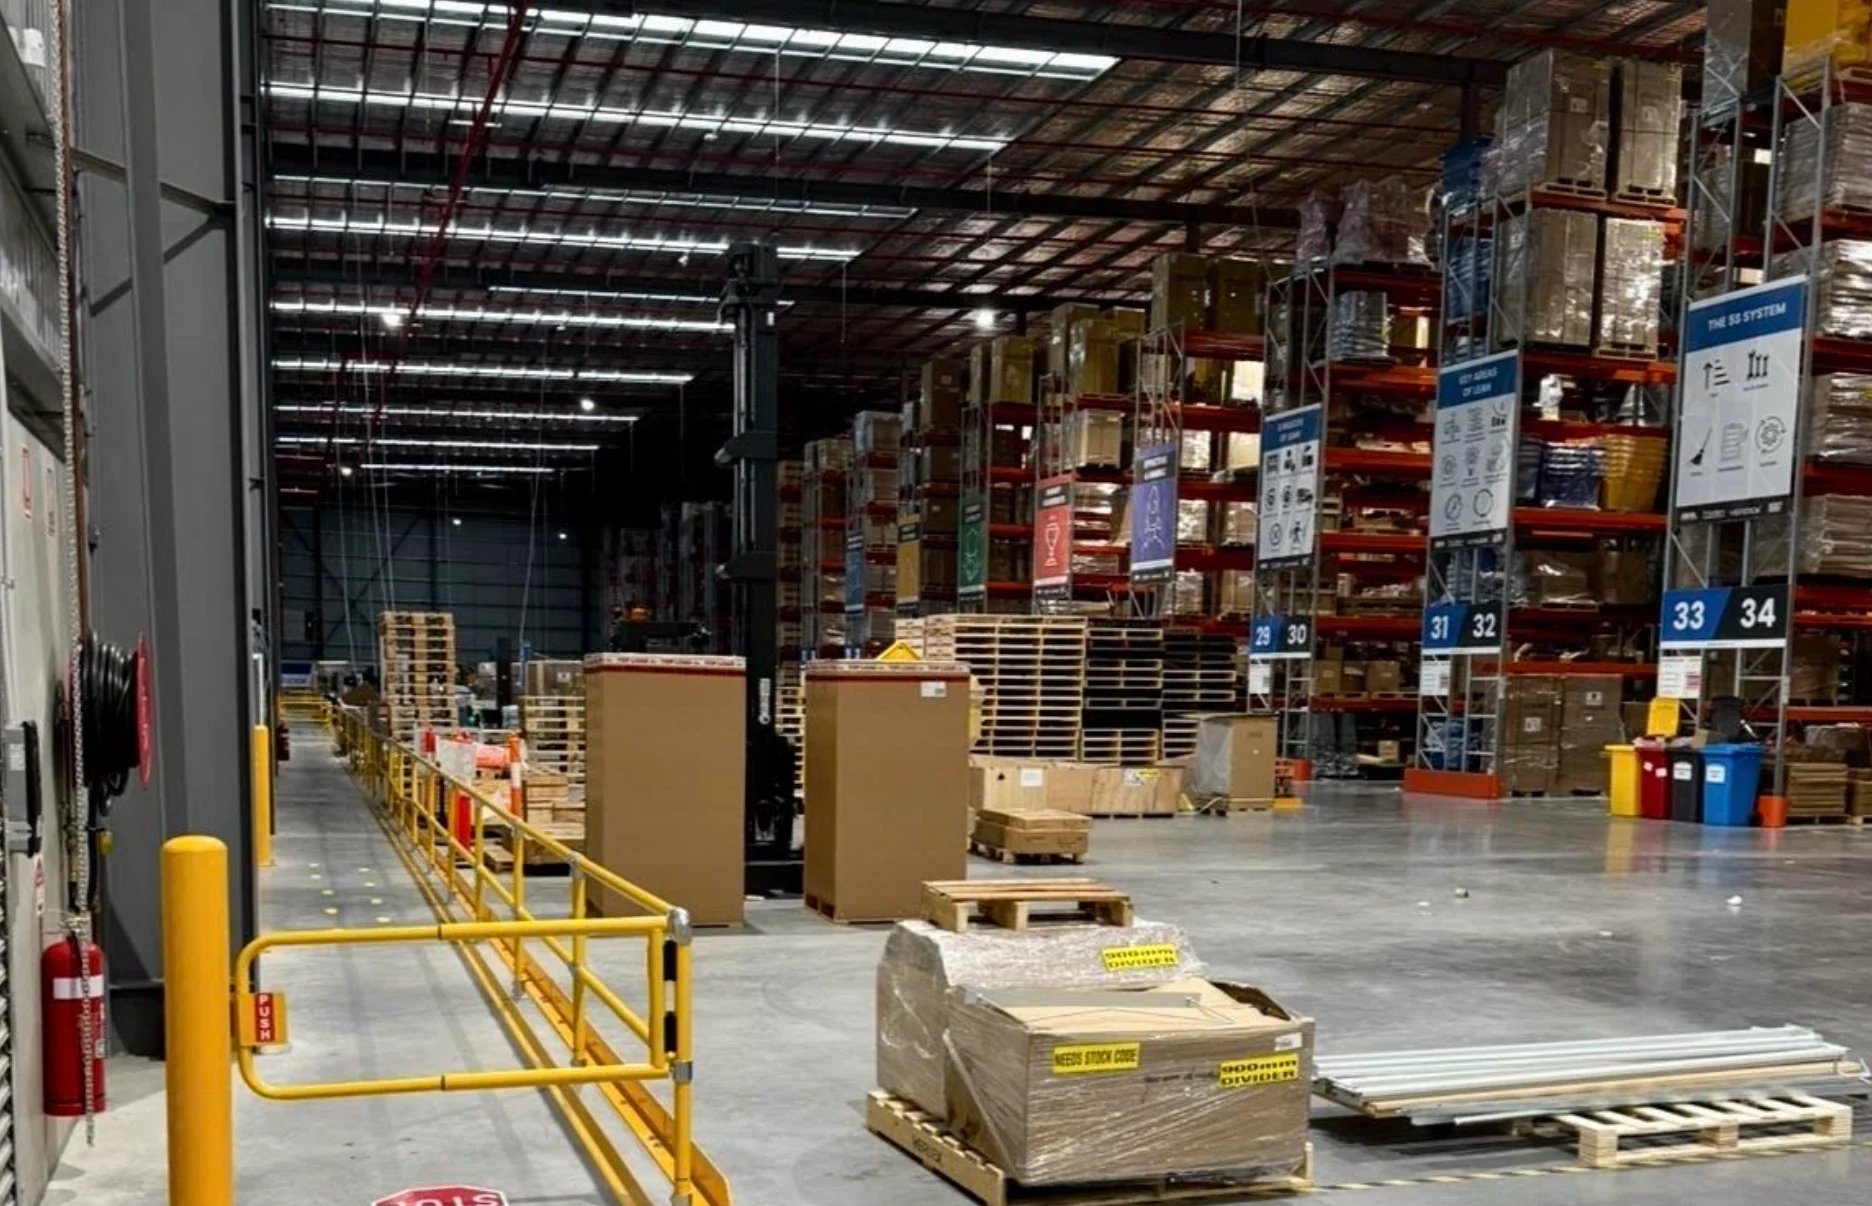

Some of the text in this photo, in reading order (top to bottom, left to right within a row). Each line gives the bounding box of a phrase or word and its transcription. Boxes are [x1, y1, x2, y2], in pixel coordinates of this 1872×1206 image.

[1708, 316, 1726, 331] THE
[1743, 302, 1787, 322] SYSTEM
[1673, 598, 1776, 630] 33 34
[1255, 624, 1307, 646] 29 30
[1430, 612, 1496, 639] 31 32
[1105, 949, 1173, 959] 900mm
[1108, 957, 1174, 968] DIVIDER
[259, 994, 270, 1040] PUSH
[1055, 1048, 1137, 1067] NEEDS STOCK CODE
[1222, 1059, 1297, 1074] 900mm
[1221, 1070, 1294, 1086] DIVIDER
